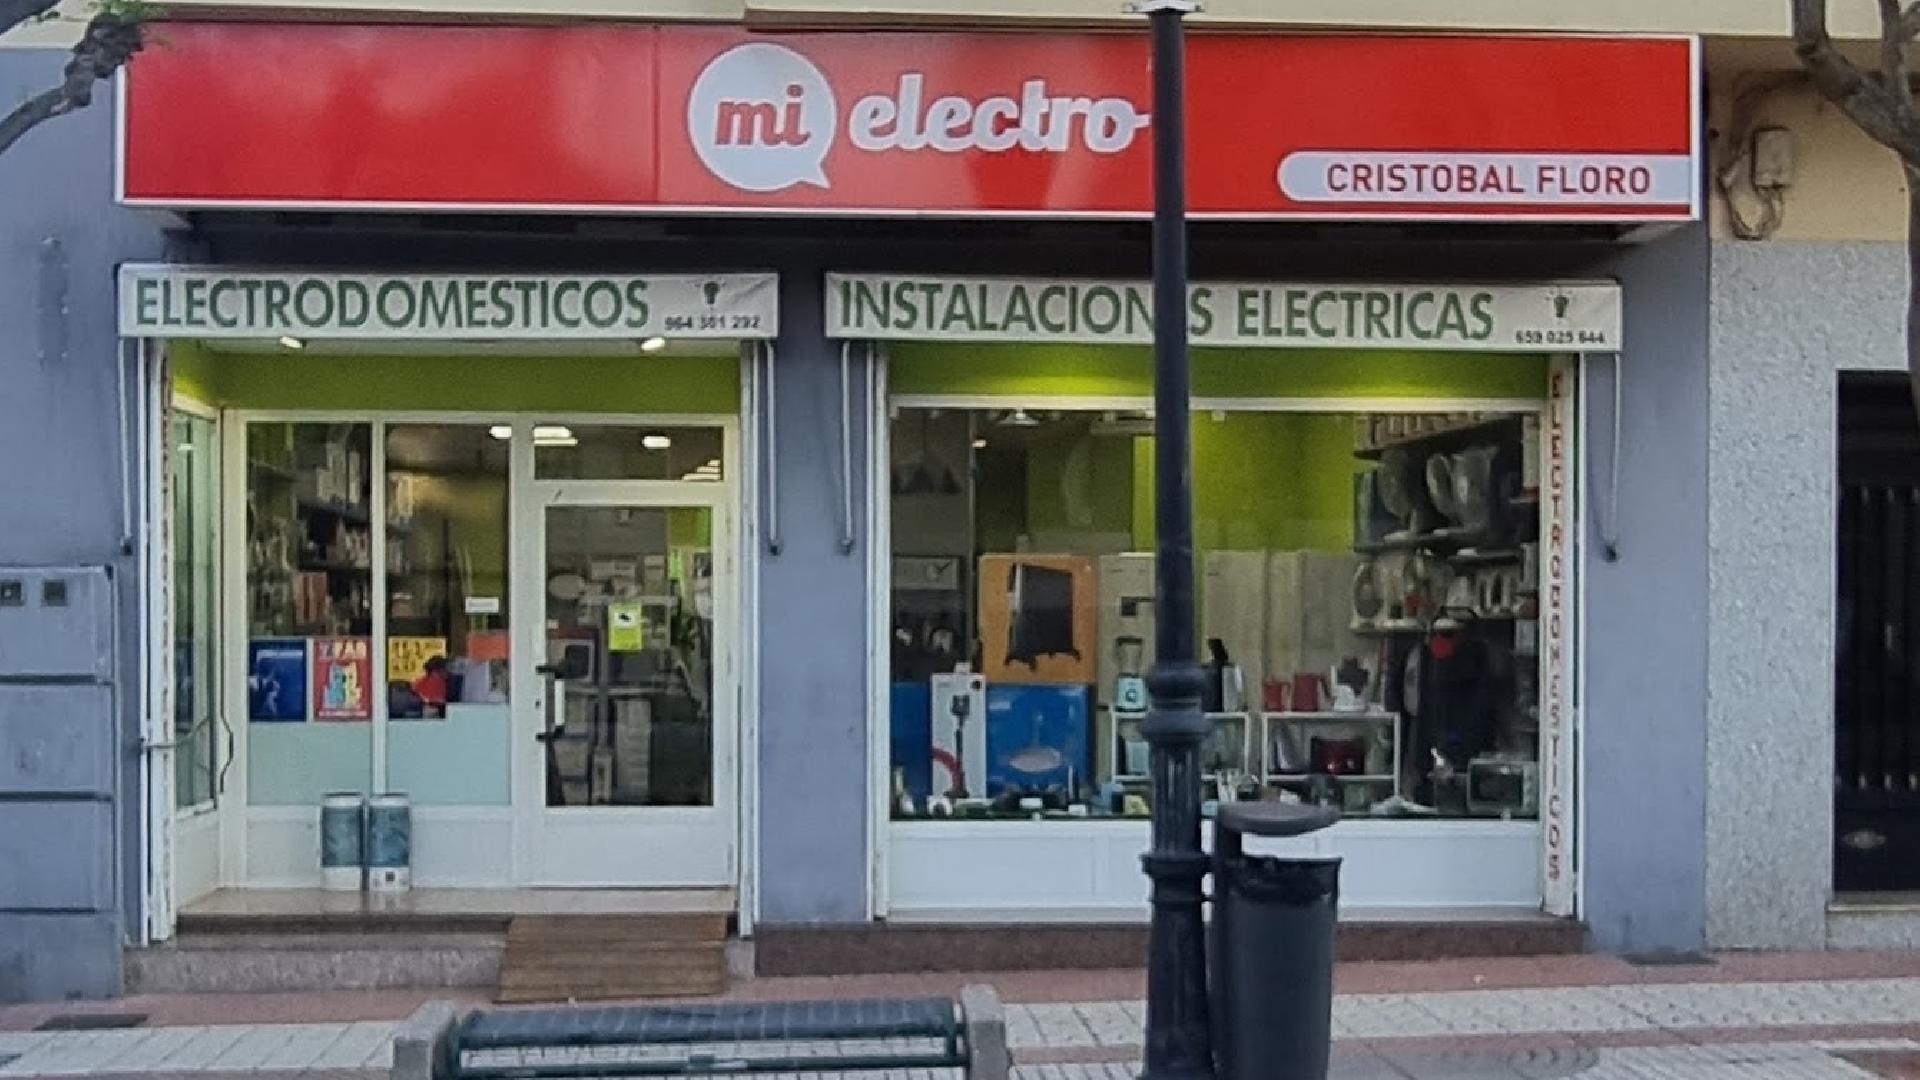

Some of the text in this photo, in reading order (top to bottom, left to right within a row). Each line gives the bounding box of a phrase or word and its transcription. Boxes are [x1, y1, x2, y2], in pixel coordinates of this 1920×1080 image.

[714, 72, 1150, 152] mi electro
[1327, 163, 1651, 195] CRISTOBAL FLORO
[136, 279, 648, 329] ELECTRODOMESTICOS
[841, 280, 1494, 341] INSTALACIONS ELECTRICAS
